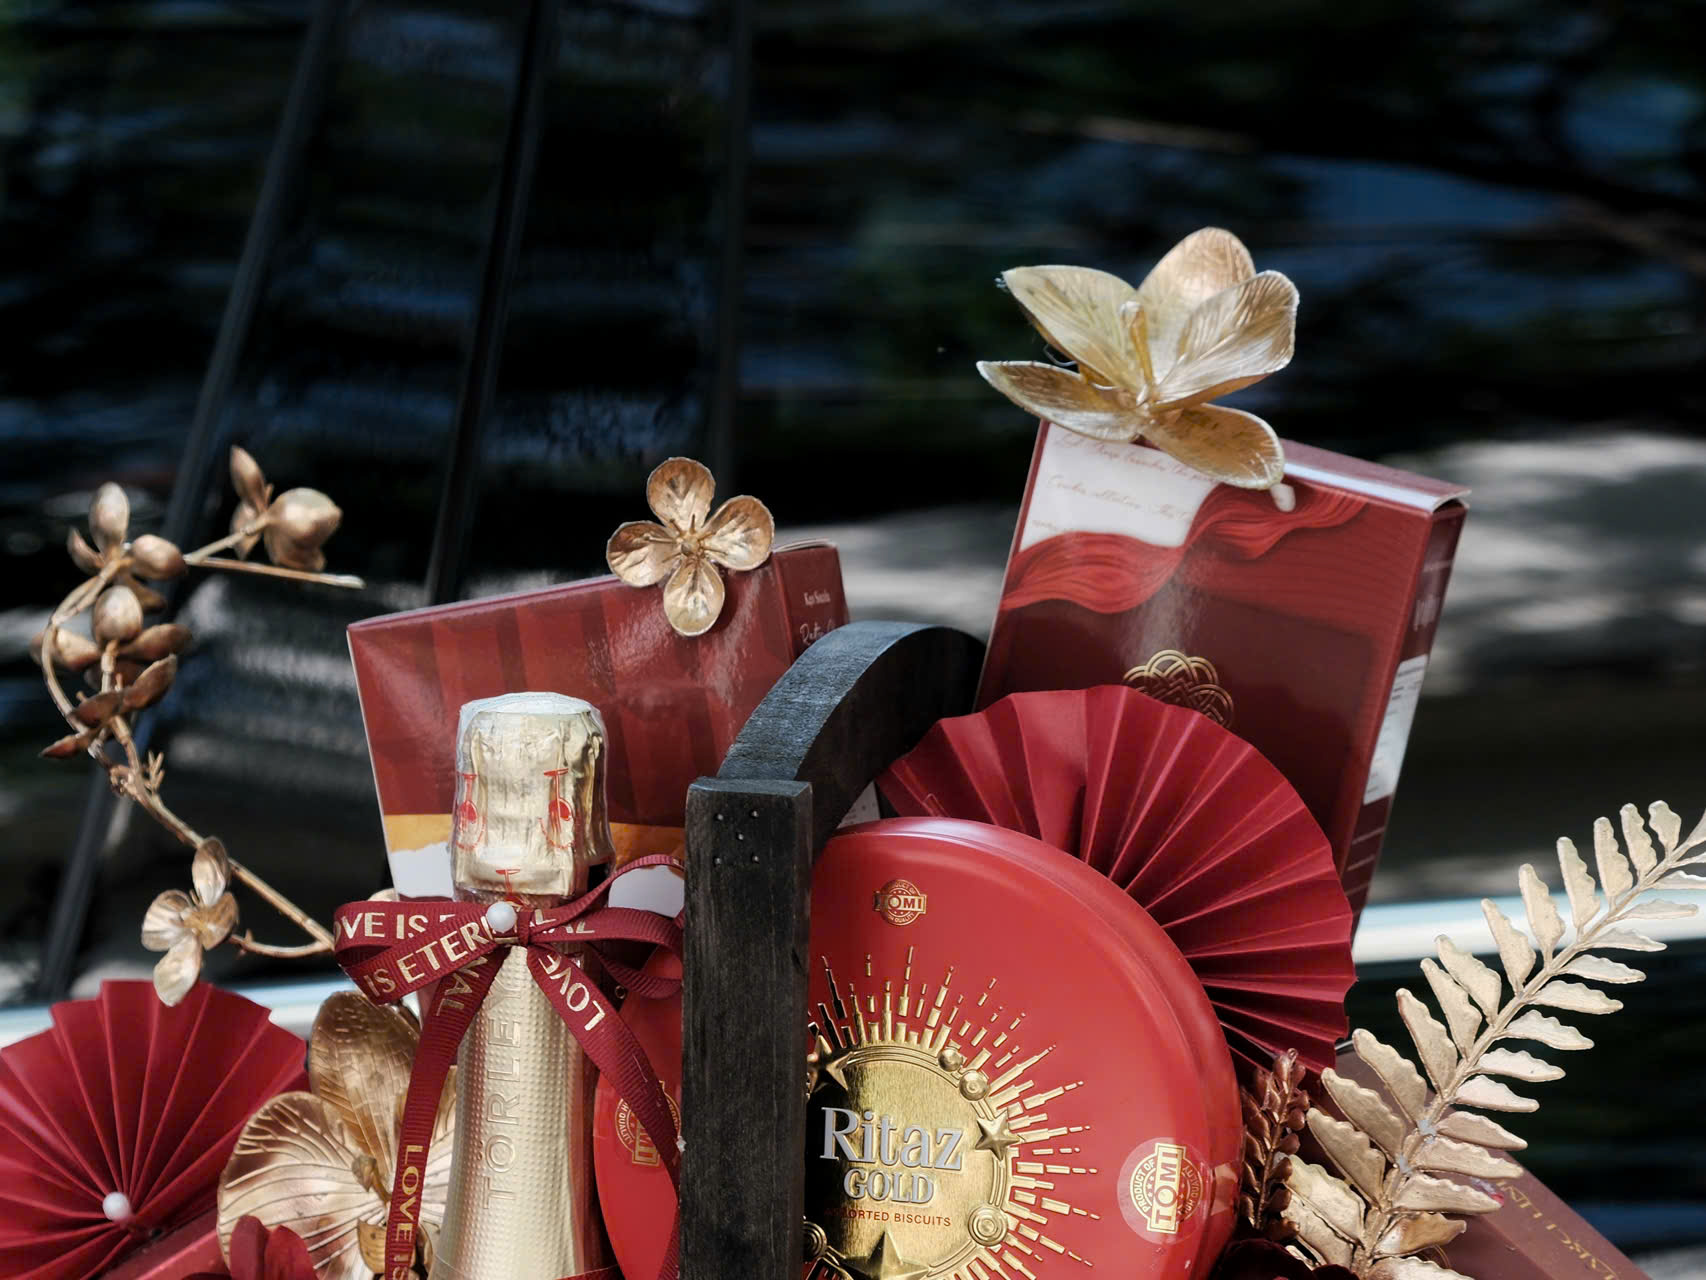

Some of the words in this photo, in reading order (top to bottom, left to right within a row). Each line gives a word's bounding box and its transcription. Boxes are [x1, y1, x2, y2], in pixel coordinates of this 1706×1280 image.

[537, 952, 607, 1032] LOVE
[819, 1106, 964, 1171] Ritaz
[399, 1145, 423, 1242] LOVE
[843, 1167, 935, 1204] GOLD
[1132, 1168, 1152, 1214] PRODUCT
[1143, 1158, 1156, 1172] OF
[1154, 1151, 1179, 1225] TOMI
[893, 1212, 952, 1227] BISCUITS
